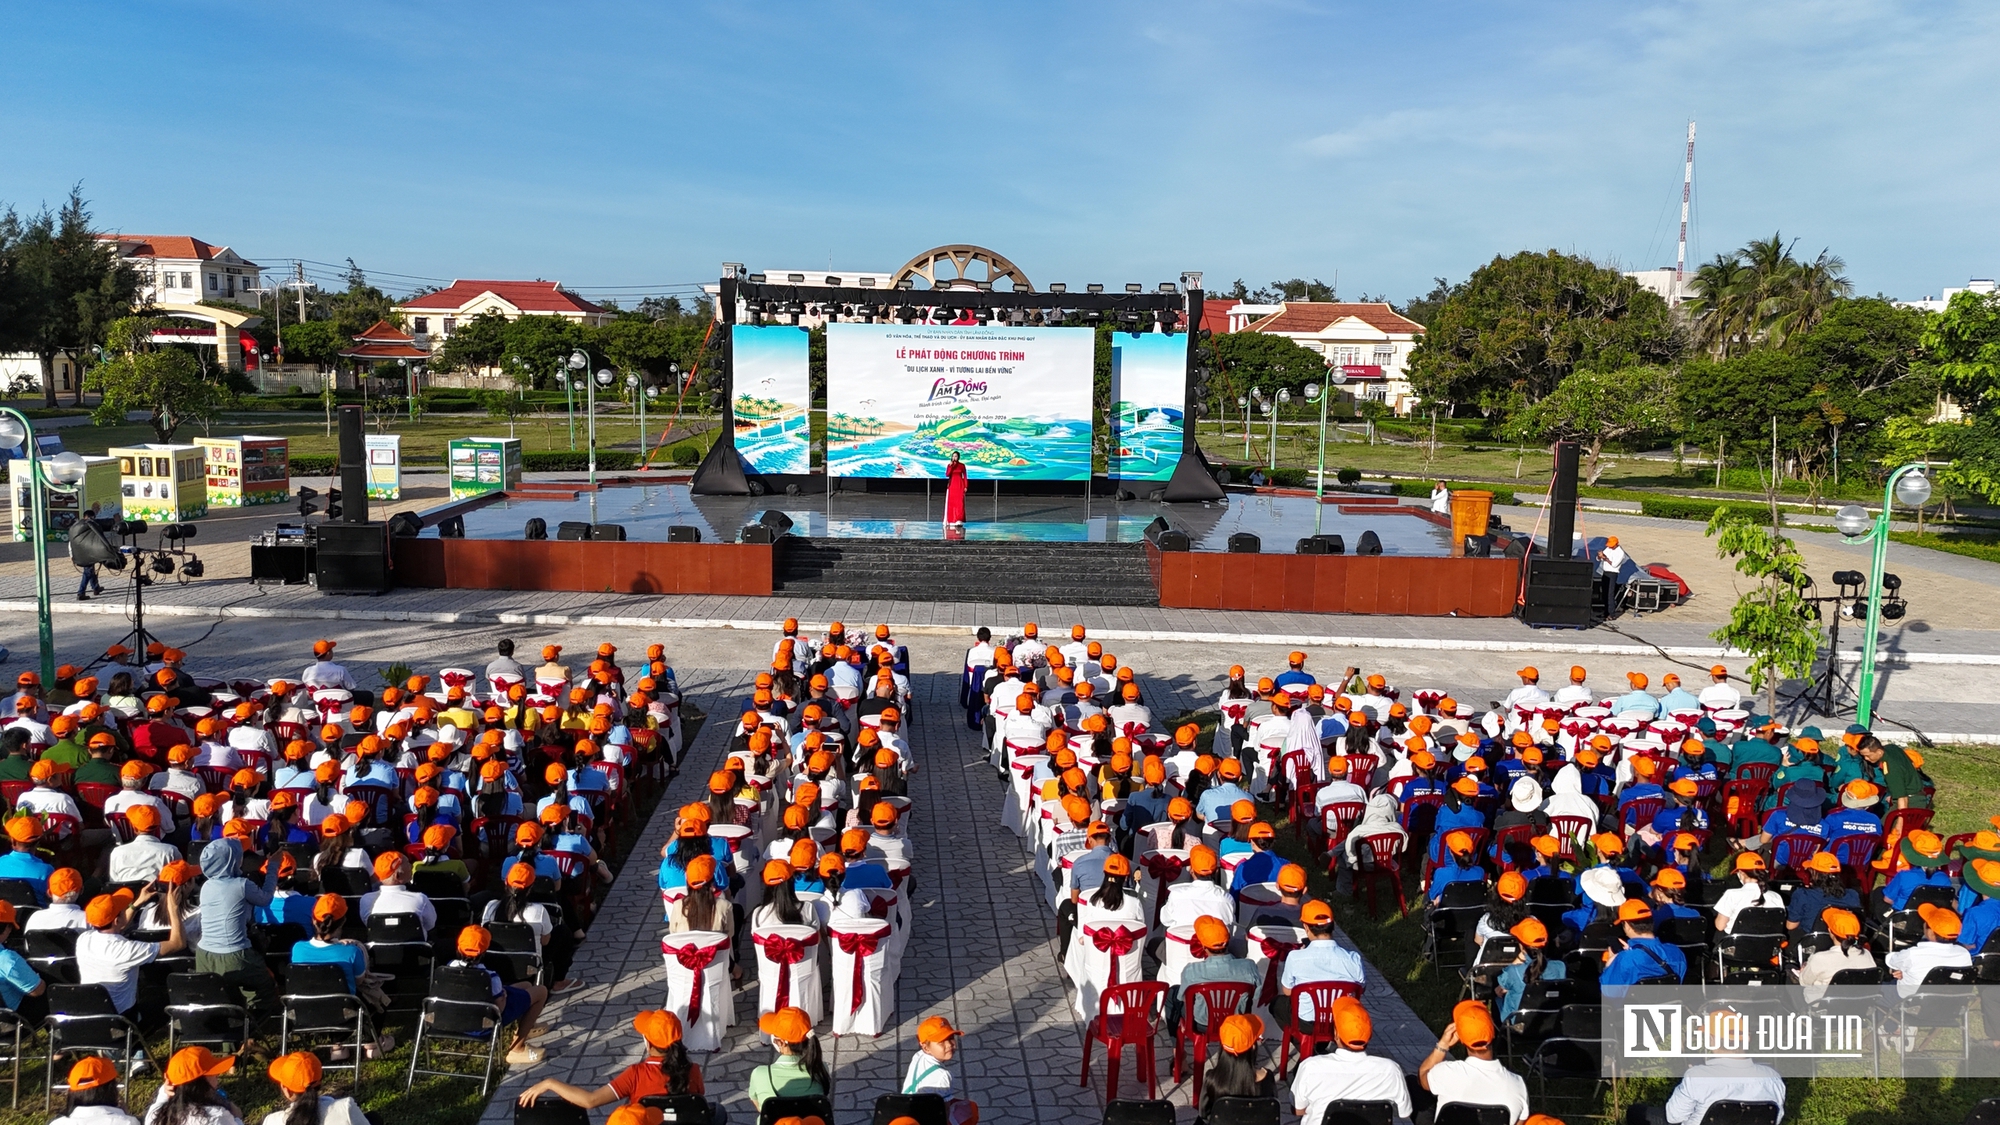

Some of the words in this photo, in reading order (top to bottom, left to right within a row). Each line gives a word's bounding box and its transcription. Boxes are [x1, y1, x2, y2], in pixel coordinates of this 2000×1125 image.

[896, 346, 906, 359] LỄ
[909, 348, 931, 359] PHÁT
[934, 348, 958, 362] ĐỘNG
[961, 350, 996, 360] CHƯƠNG
[999, 349, 1025, 361] TRÌNH
[916, 366, 928, 374] LỊCH
[956, 366, 974, 374] TƯƠNG
[975, 366, 984, 374] LAI
[953, 378, 988, 397] ĐỒNG
